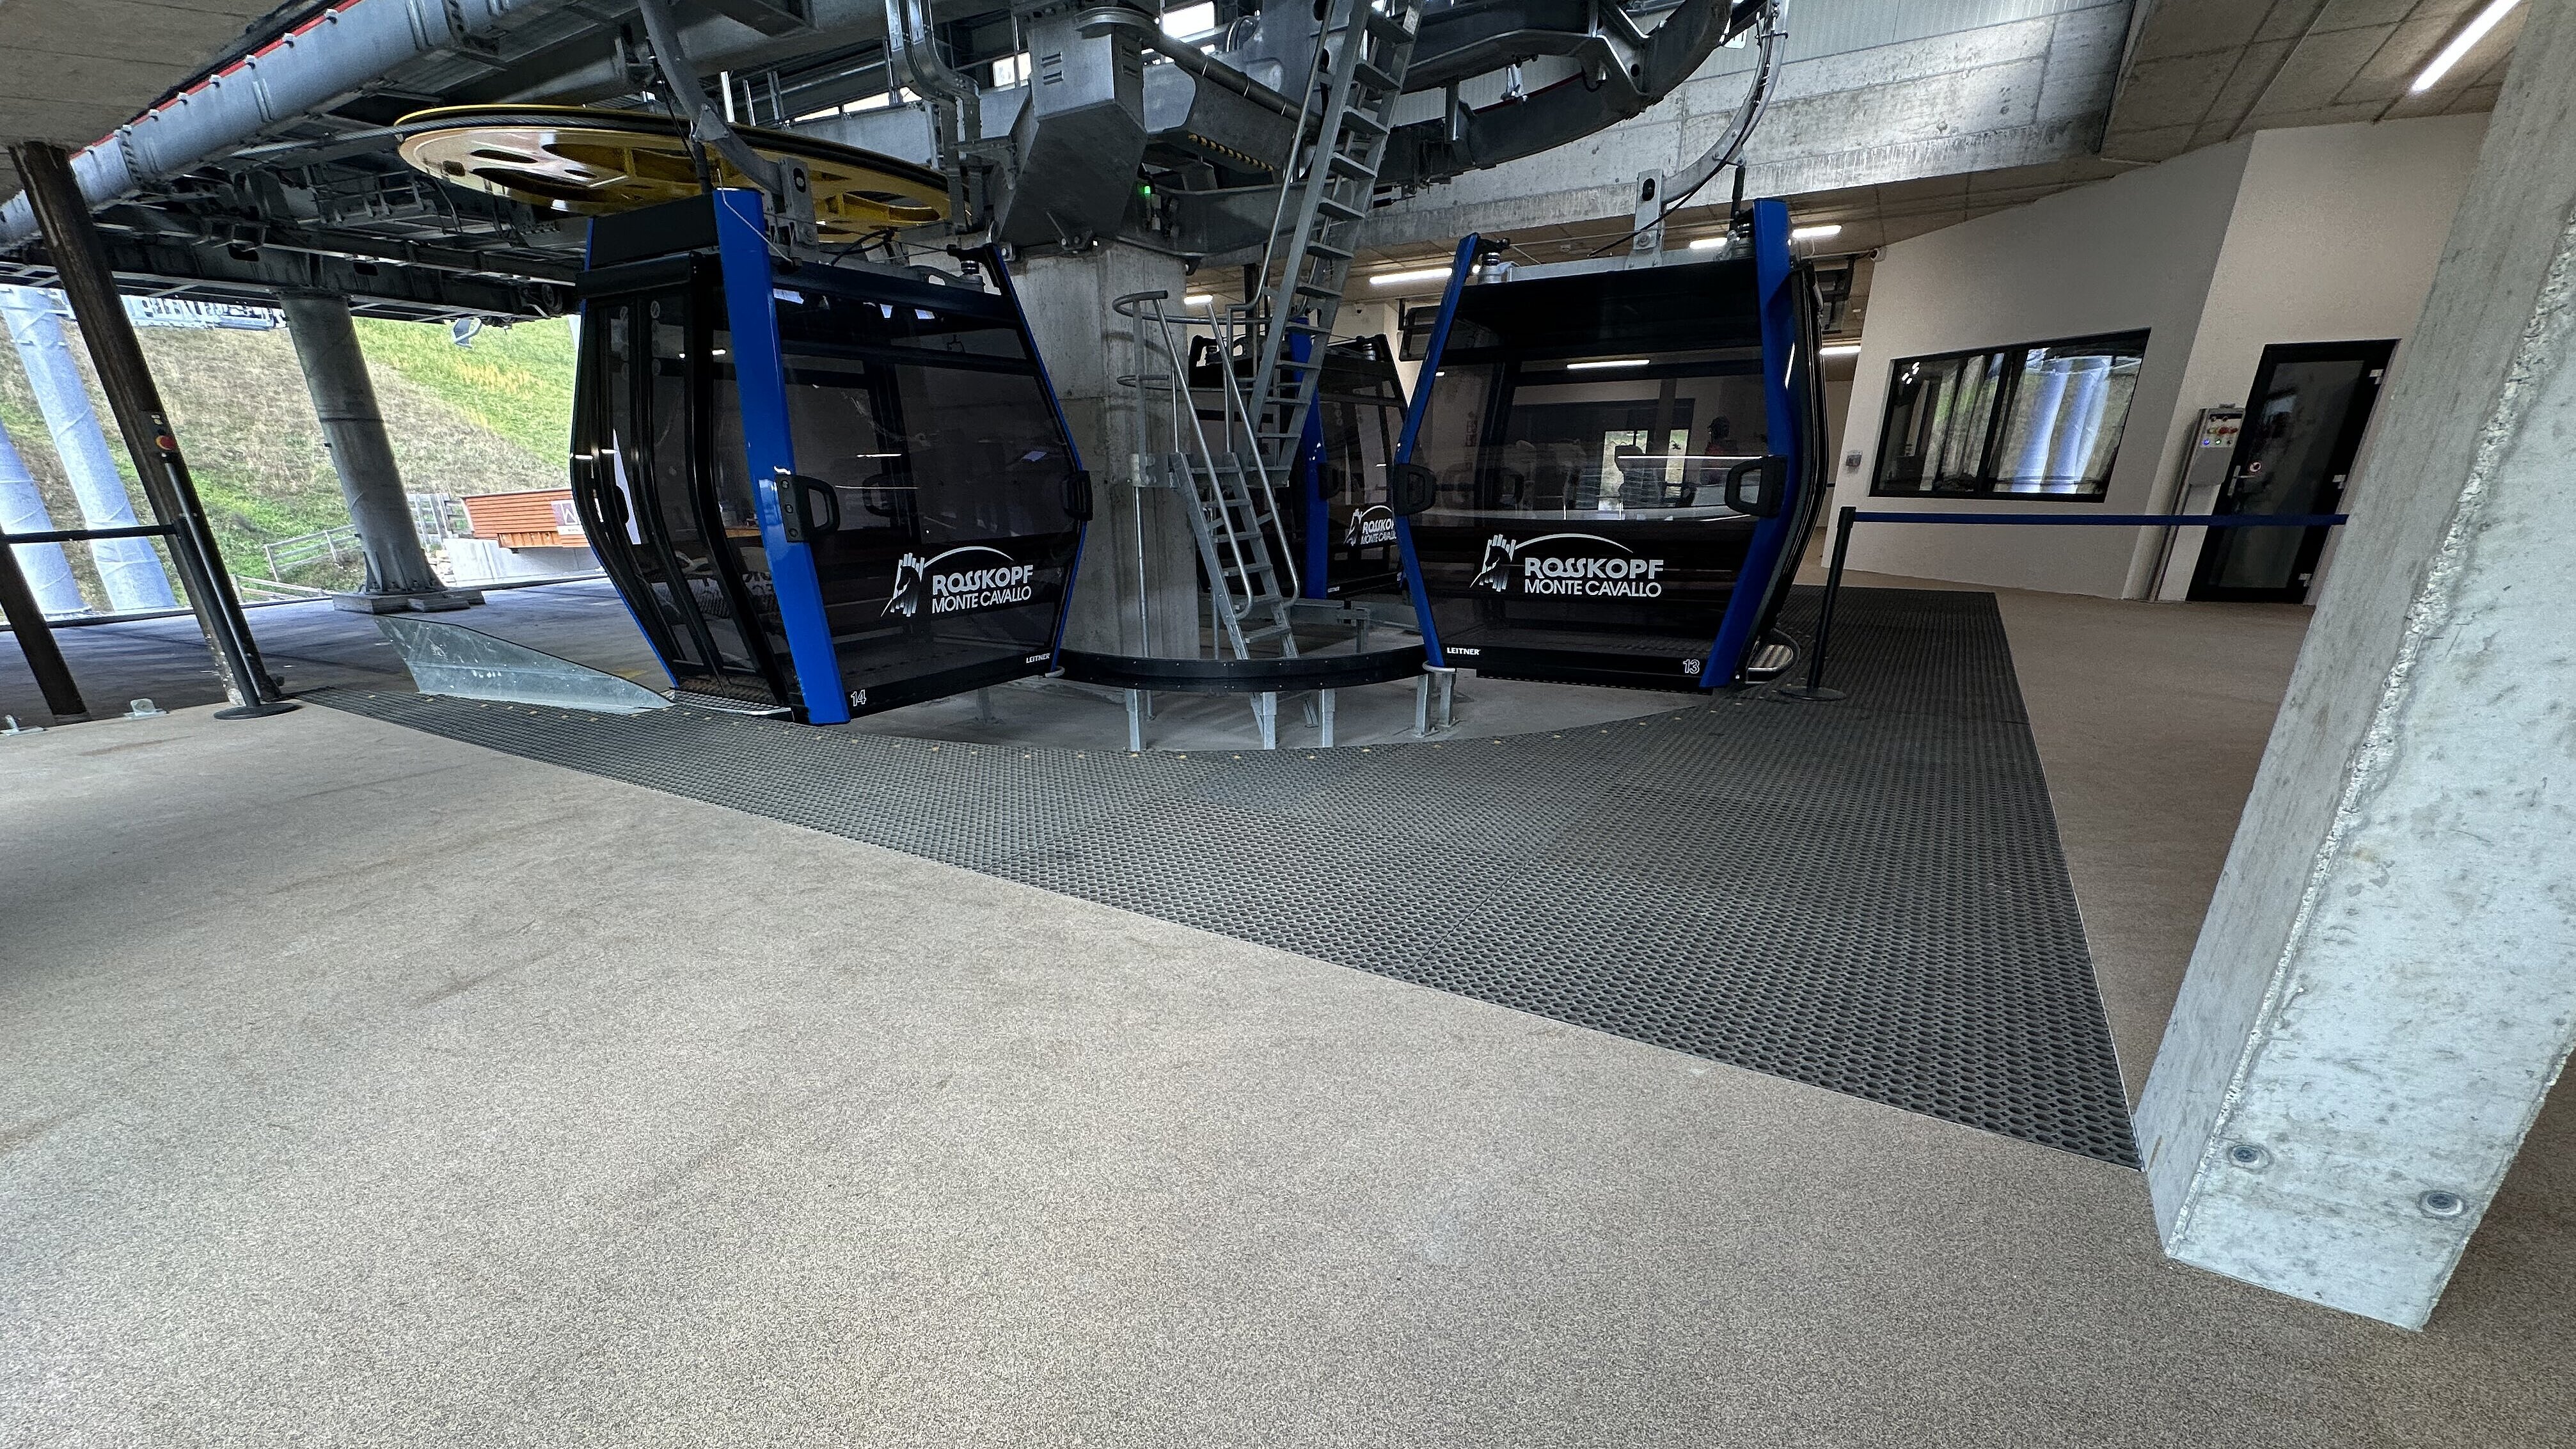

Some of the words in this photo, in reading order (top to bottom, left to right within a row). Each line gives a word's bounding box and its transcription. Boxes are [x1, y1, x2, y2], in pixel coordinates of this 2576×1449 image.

[1525, 557, 1663, 579] ROSSKOPF
[933, 565, 1033, 596] ROSSKOPF
[1525, 579, 1582, 594] MONTE
[1585, 580, 1662, 598] CAVALLO
[932, 592, 979, 614] MONTE
[980, 586, 1032, 606] CAVALLO
[1025, 653, 1051, 663] LEITNER
[1682, 659, 1700, 674] 13
[850, 689, 867, 707] 14
